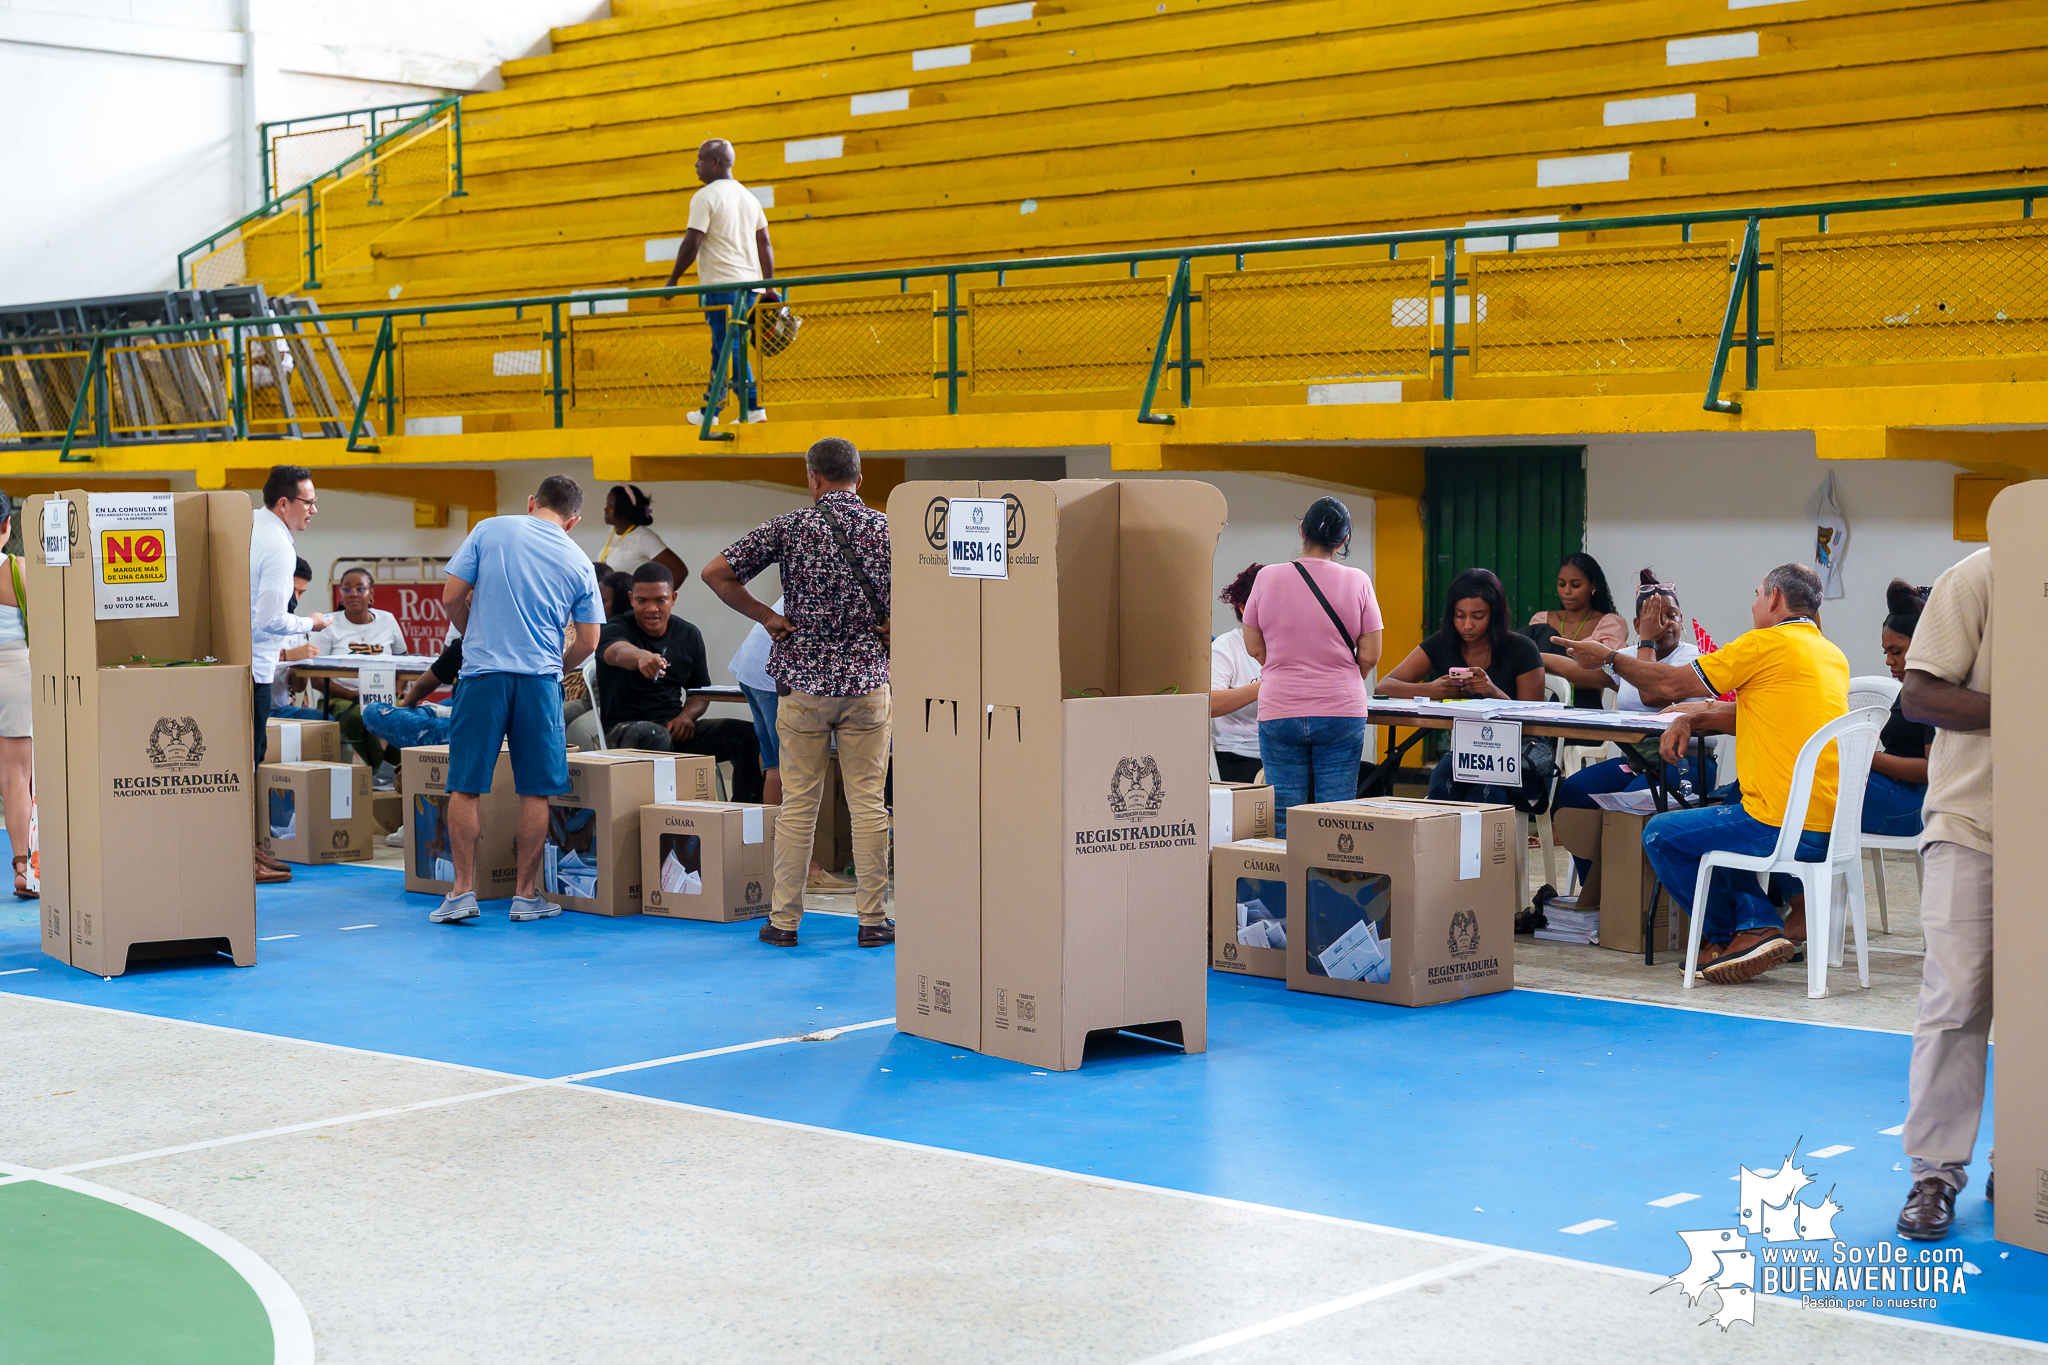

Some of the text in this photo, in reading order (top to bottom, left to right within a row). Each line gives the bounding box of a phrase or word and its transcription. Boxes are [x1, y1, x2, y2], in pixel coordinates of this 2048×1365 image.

[46, 536, 67, 552] MESA 17
[107, 535, 162, 563] NO
[952, 540, 1002, 563] MESA 16
[918, 553, 948, 566] Prohibid
[1015, 552, 1040, 565] celular
[363, 693, 394, 706] MESA 18
[418, 755, 450, 765] CONSULTA
[1458, 752, 1516, 773] MESA 16
[113, 769, 240, 789] REGISTRADURÍA
[113, 789, 158, 798] NACIONAL
[180, 786, 215, 795] ESTADO
[217, 785, 240, 793] CIVIL
[665, 816, 695, 828] CÁMARA
[1317, 817, 1374, 832] CONSULTAS
[1075, 818, 1197, 845] REGISTRADURÍA
[1075, 837, 1197, 855] NACIONAL DEL ESTADO CIVIL
[1243, 858, 1281, 873] CÁMARA
[1428, 955, 1499, 978] REGISTRADURÍA
[1428, 968, 1499, 986] NACIONAL DEL ESTADO CIVIL
